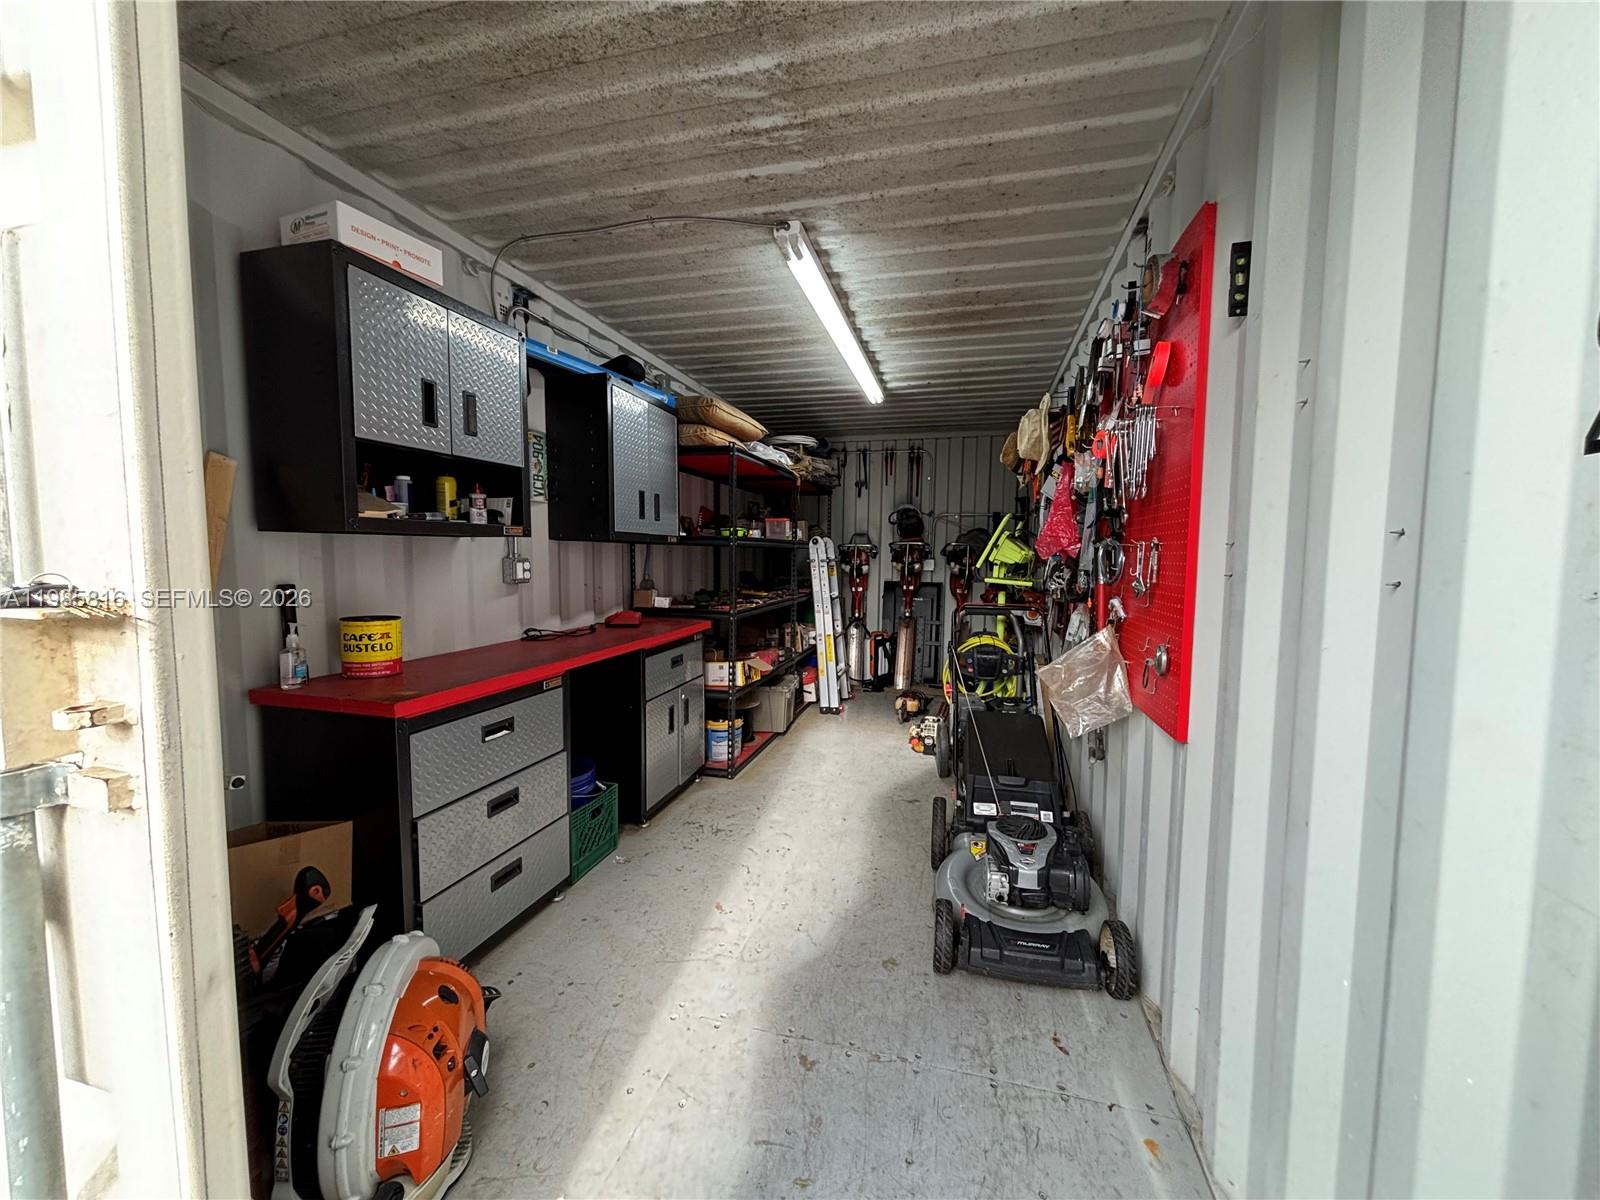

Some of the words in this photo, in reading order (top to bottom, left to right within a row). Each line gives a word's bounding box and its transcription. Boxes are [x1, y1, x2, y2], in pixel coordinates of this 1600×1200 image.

[350, 225, 376, 241] DESIGN
[381, 238, 399, 252] PRINT
[403, 249, 432, 266] PROMOTE
[532, 434, 544, 459] 904
[343, 642, 394, 653] BUSTELO
[1017, 940, 1051, 949] MURRAY
